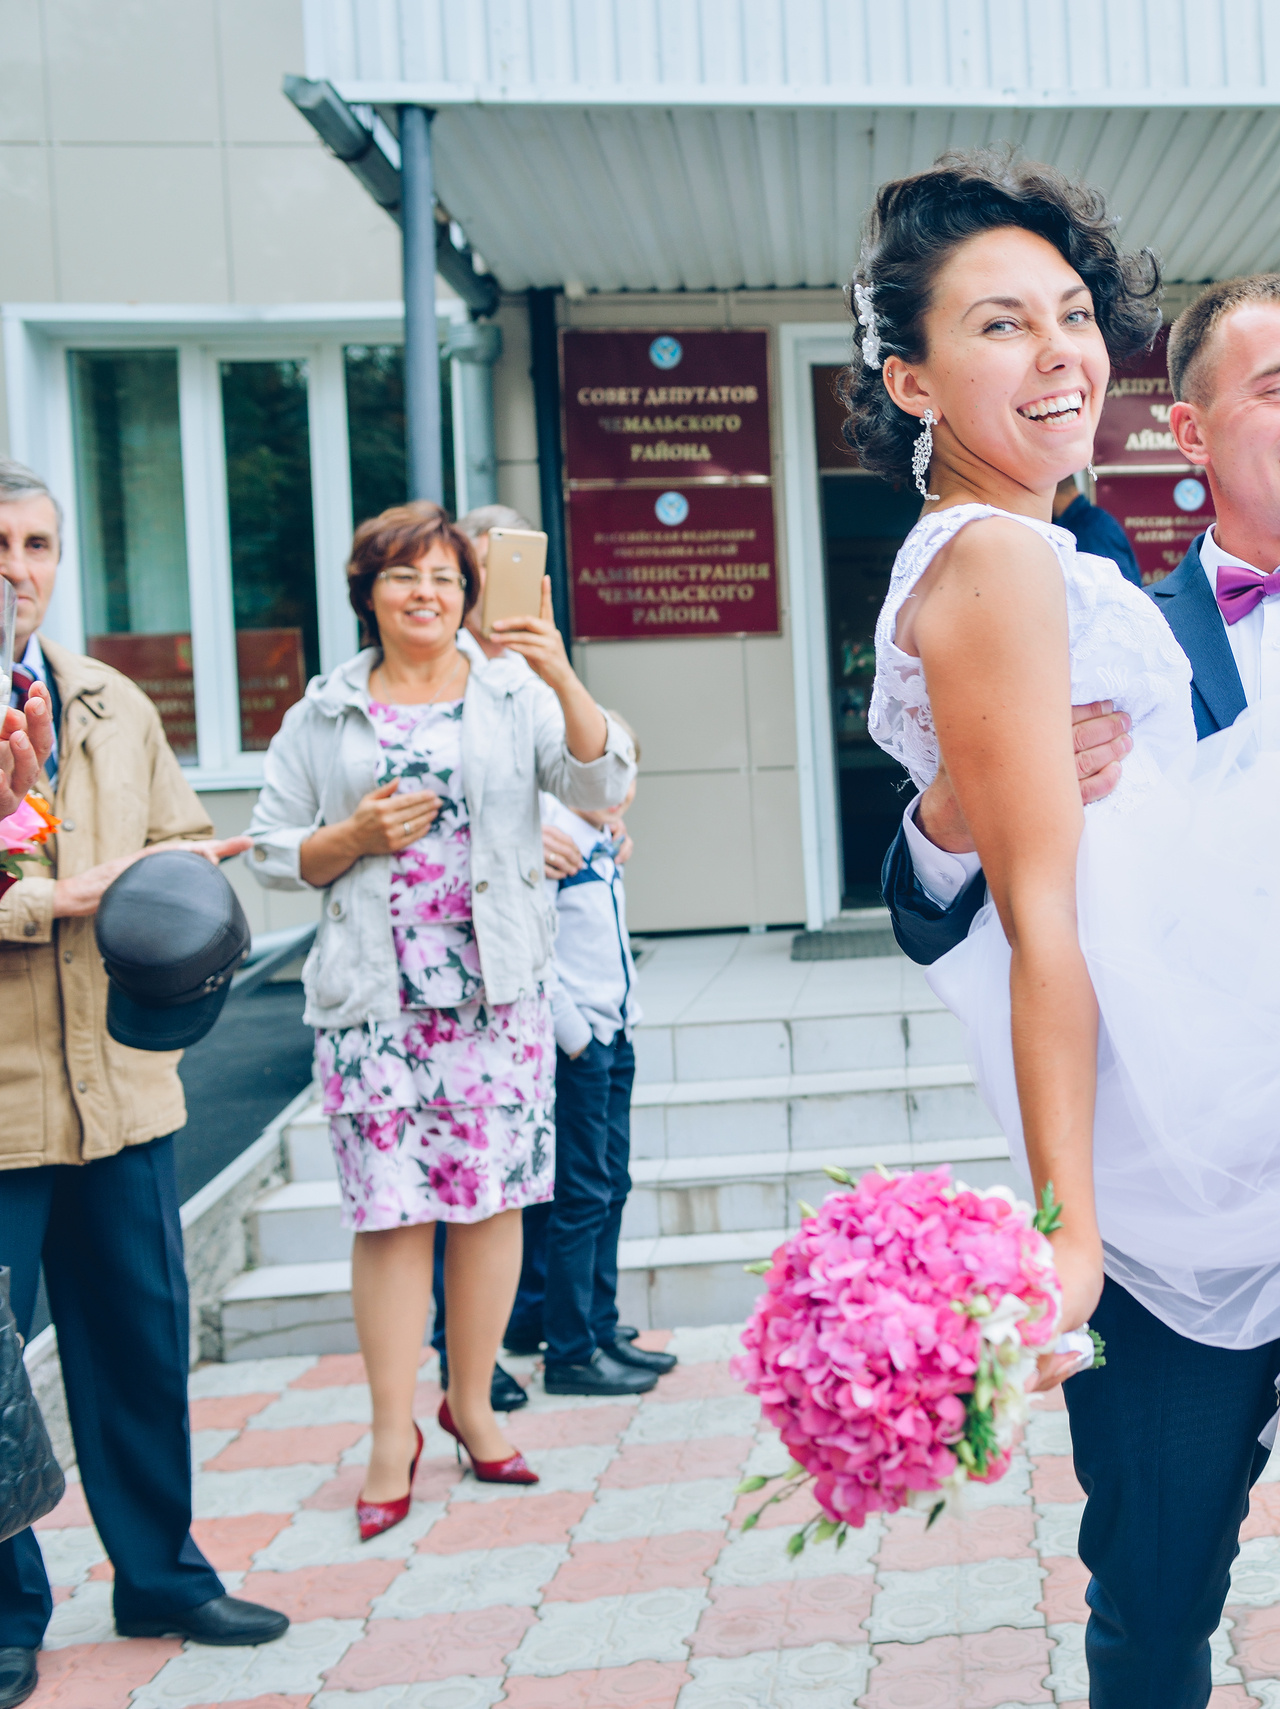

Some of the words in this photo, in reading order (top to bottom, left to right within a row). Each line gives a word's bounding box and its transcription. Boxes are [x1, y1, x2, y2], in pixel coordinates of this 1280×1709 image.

[577, 387, 642, 405] СОВЕТ
[644, 385, 758, 406] ДЕПУТАТОВ
[631, 440, 711, 461] РАЙОНА
[578, 563, 770, 585] АДМИНИСТРАЦИЯ
[598, 583, 754, 605] ЧЕМАЛЬСКОГО
[633, 604, 720, 625] РАЙОНА
